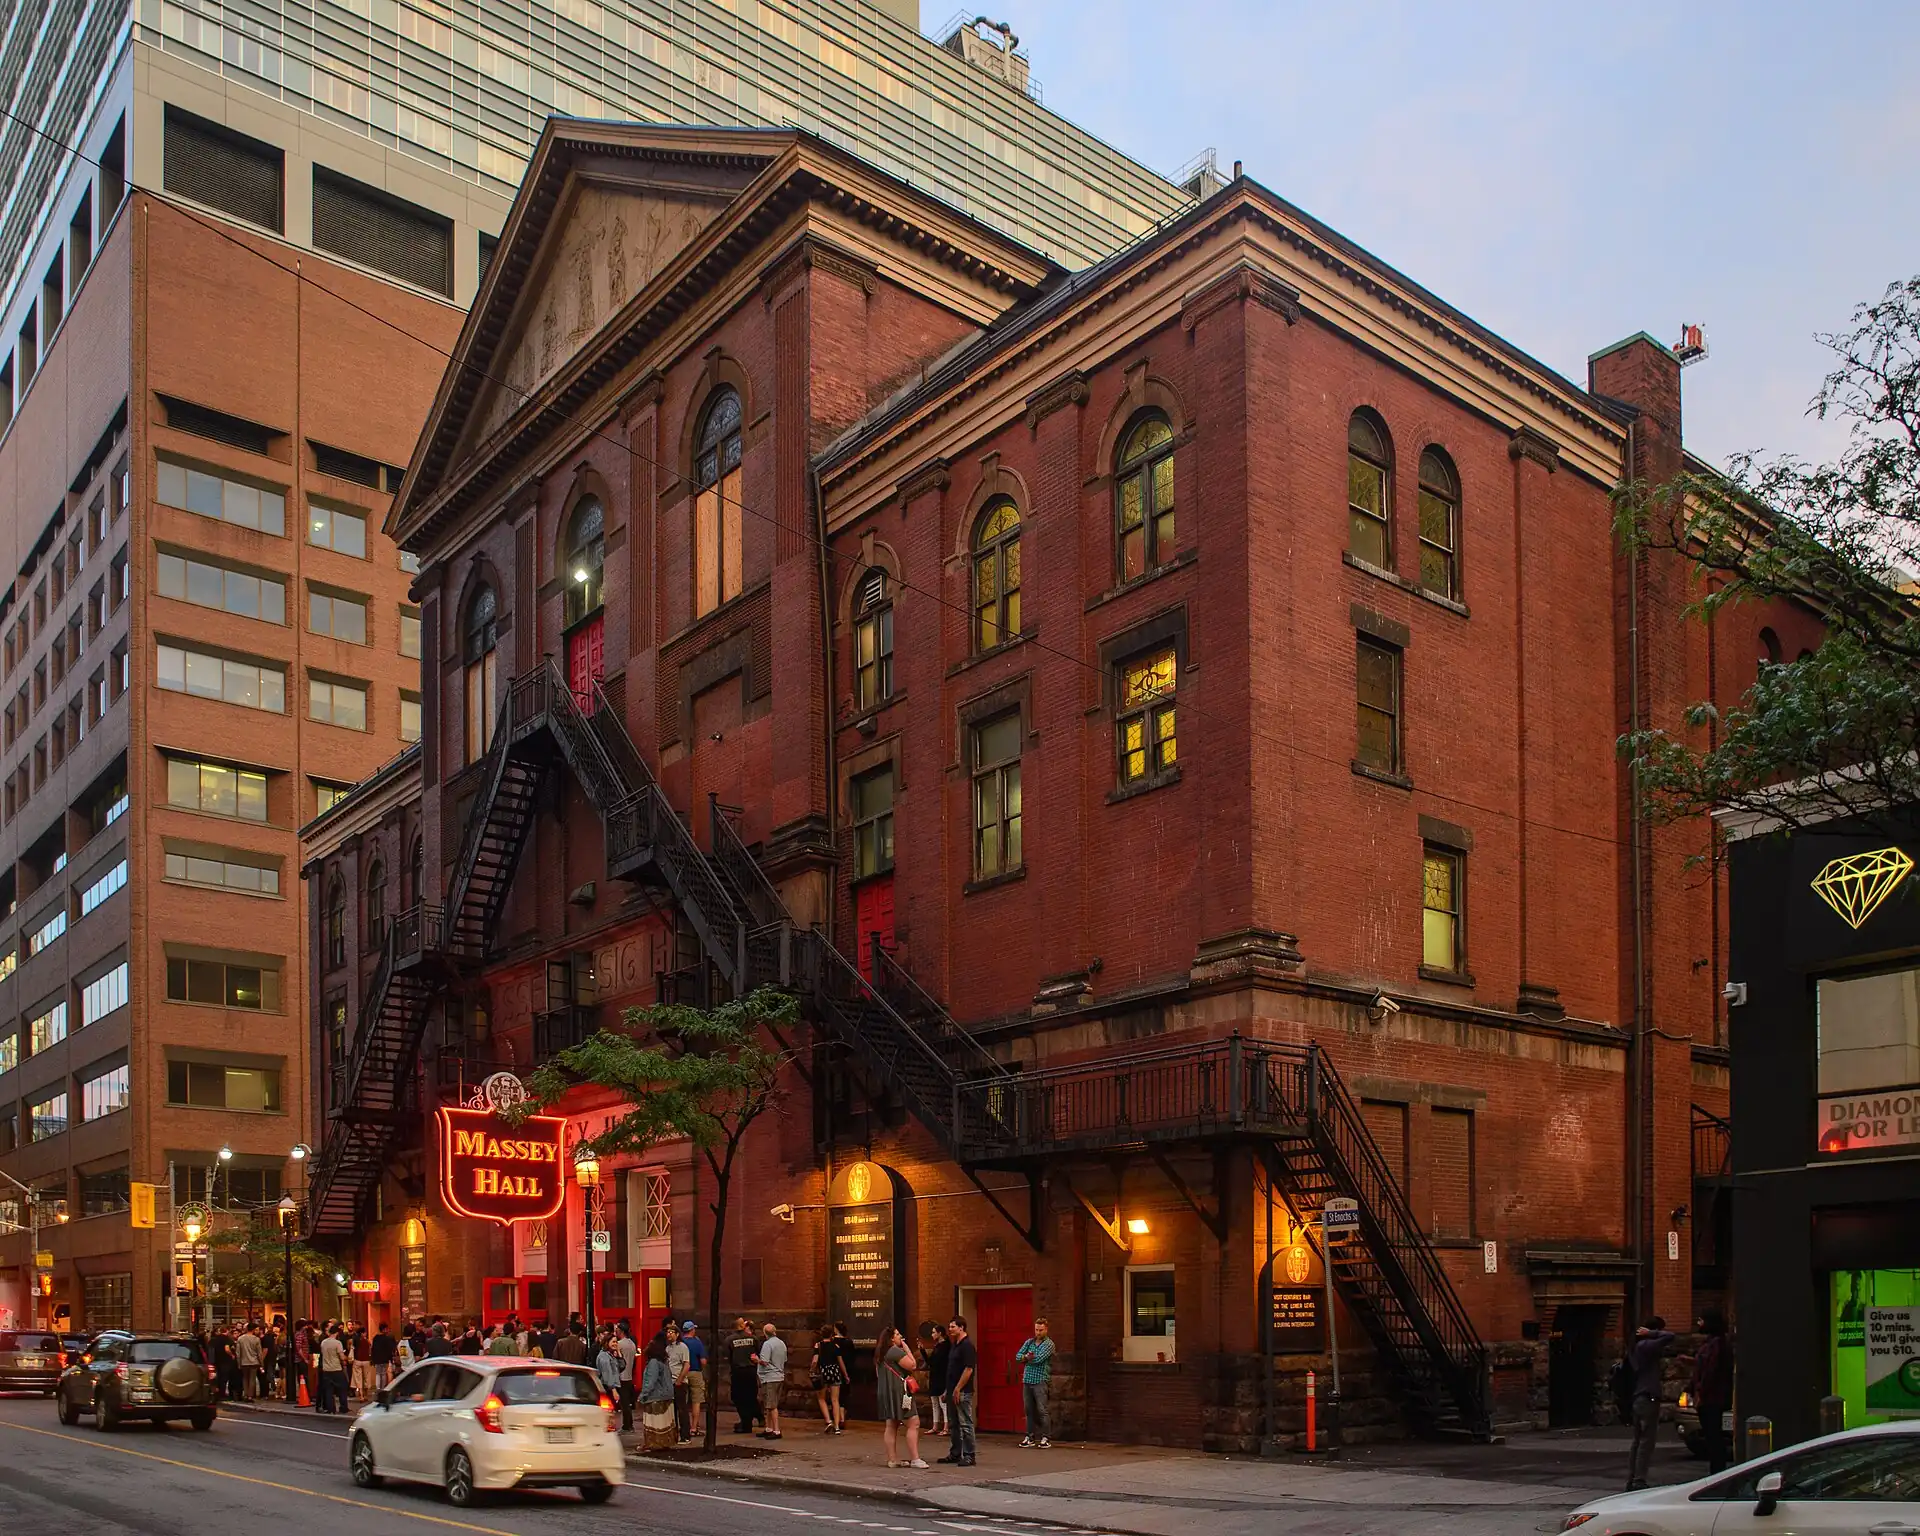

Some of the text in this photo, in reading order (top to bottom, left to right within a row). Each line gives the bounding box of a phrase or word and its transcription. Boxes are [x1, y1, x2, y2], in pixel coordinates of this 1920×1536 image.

[1897, 1115, 1920, 1135] LE
[453, 1129, 559, 1162] MASSEY
[472, 1168, 543, 1197] HALL
[1328, 1212, 1334, 1223] St
[1334, 1211, 1352, 1222] Enochs
[844, 1253, 860, 1262] LEWIS
[861, 1252, 878, 1261] BLACK
[838, 1261, 890, 1271] KATHLEEN MADIGAN
[850, 1300, 880, 1308] RODRIGUEZ
[1870, 1311, 1894, 1320] Give
[1870, 1322, 1882, 1331] 10
[1884, 1322, 1915, 1331] mins.
[1870, 1333, 1920, 1345] We'll give
[1870, 1344, 1916, 1356] you $10.
